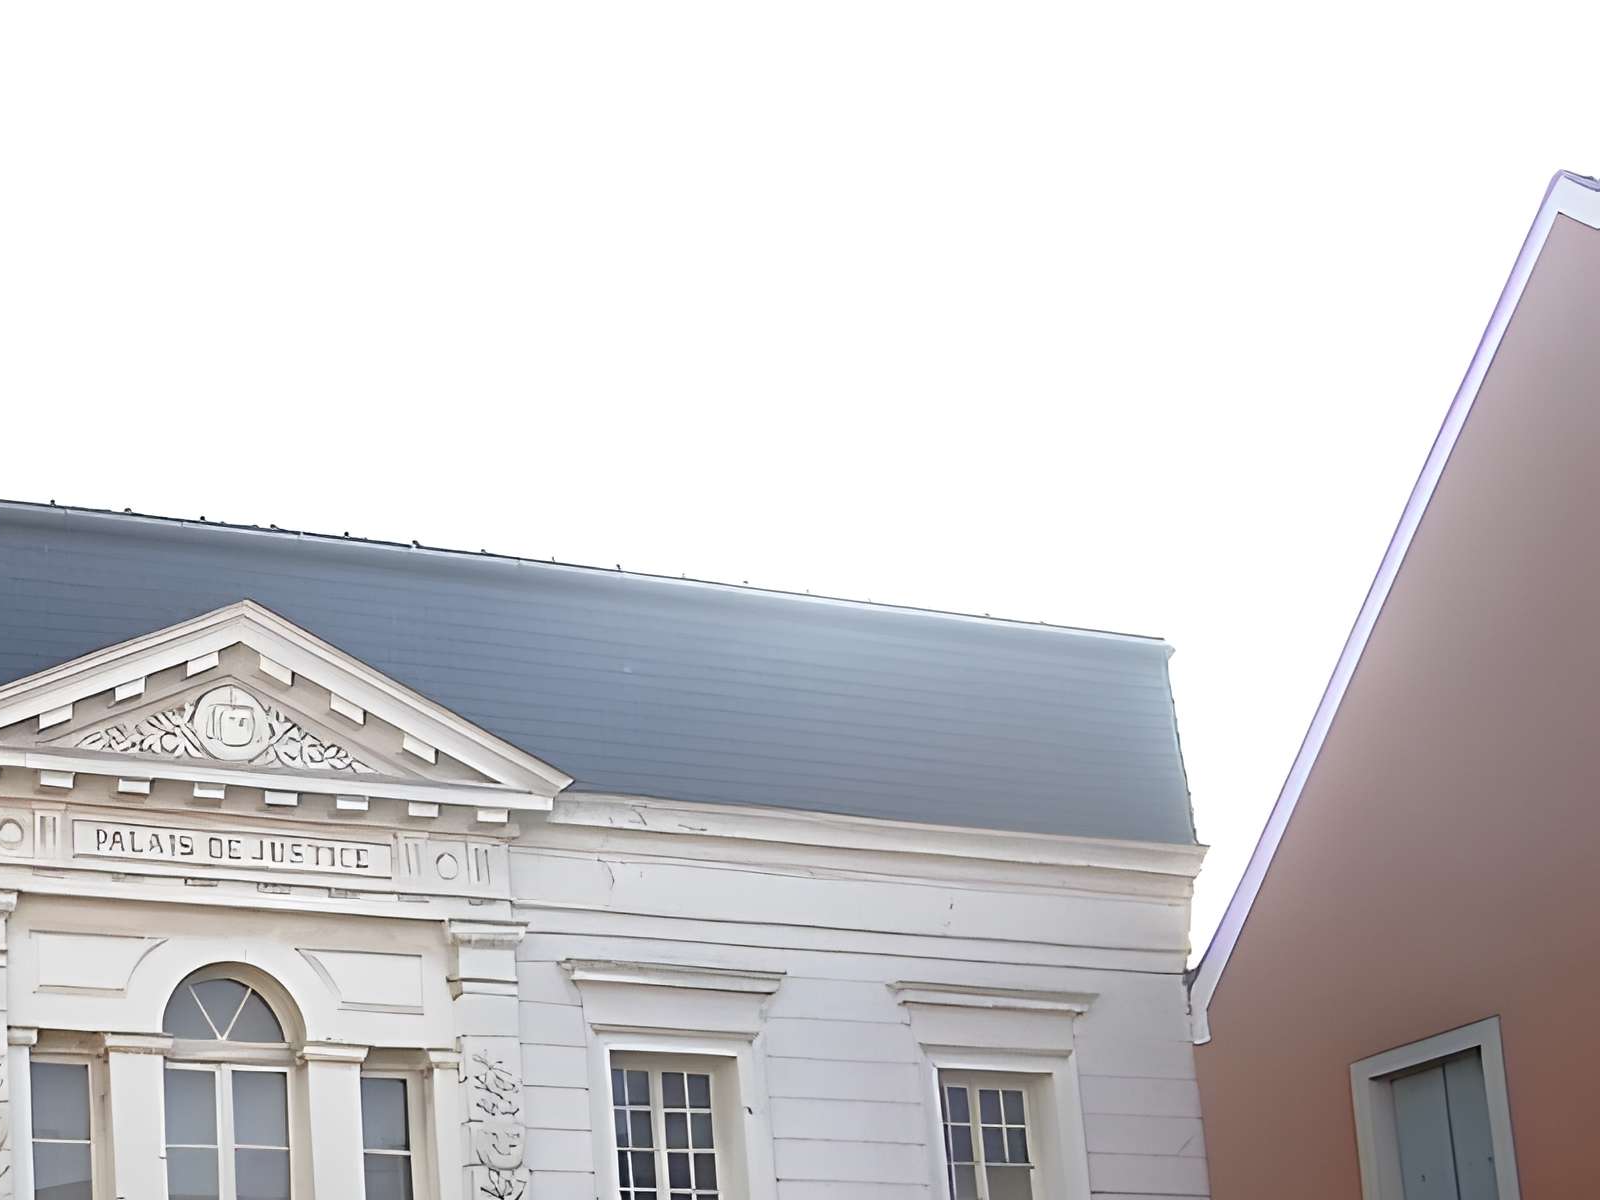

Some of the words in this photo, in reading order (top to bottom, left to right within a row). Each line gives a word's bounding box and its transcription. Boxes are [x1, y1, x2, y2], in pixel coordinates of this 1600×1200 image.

[96, 829, 194, 856] PALAIS
[208, 836, 242, 860] DE
[251, 840, 369, 869] JUSTICE
